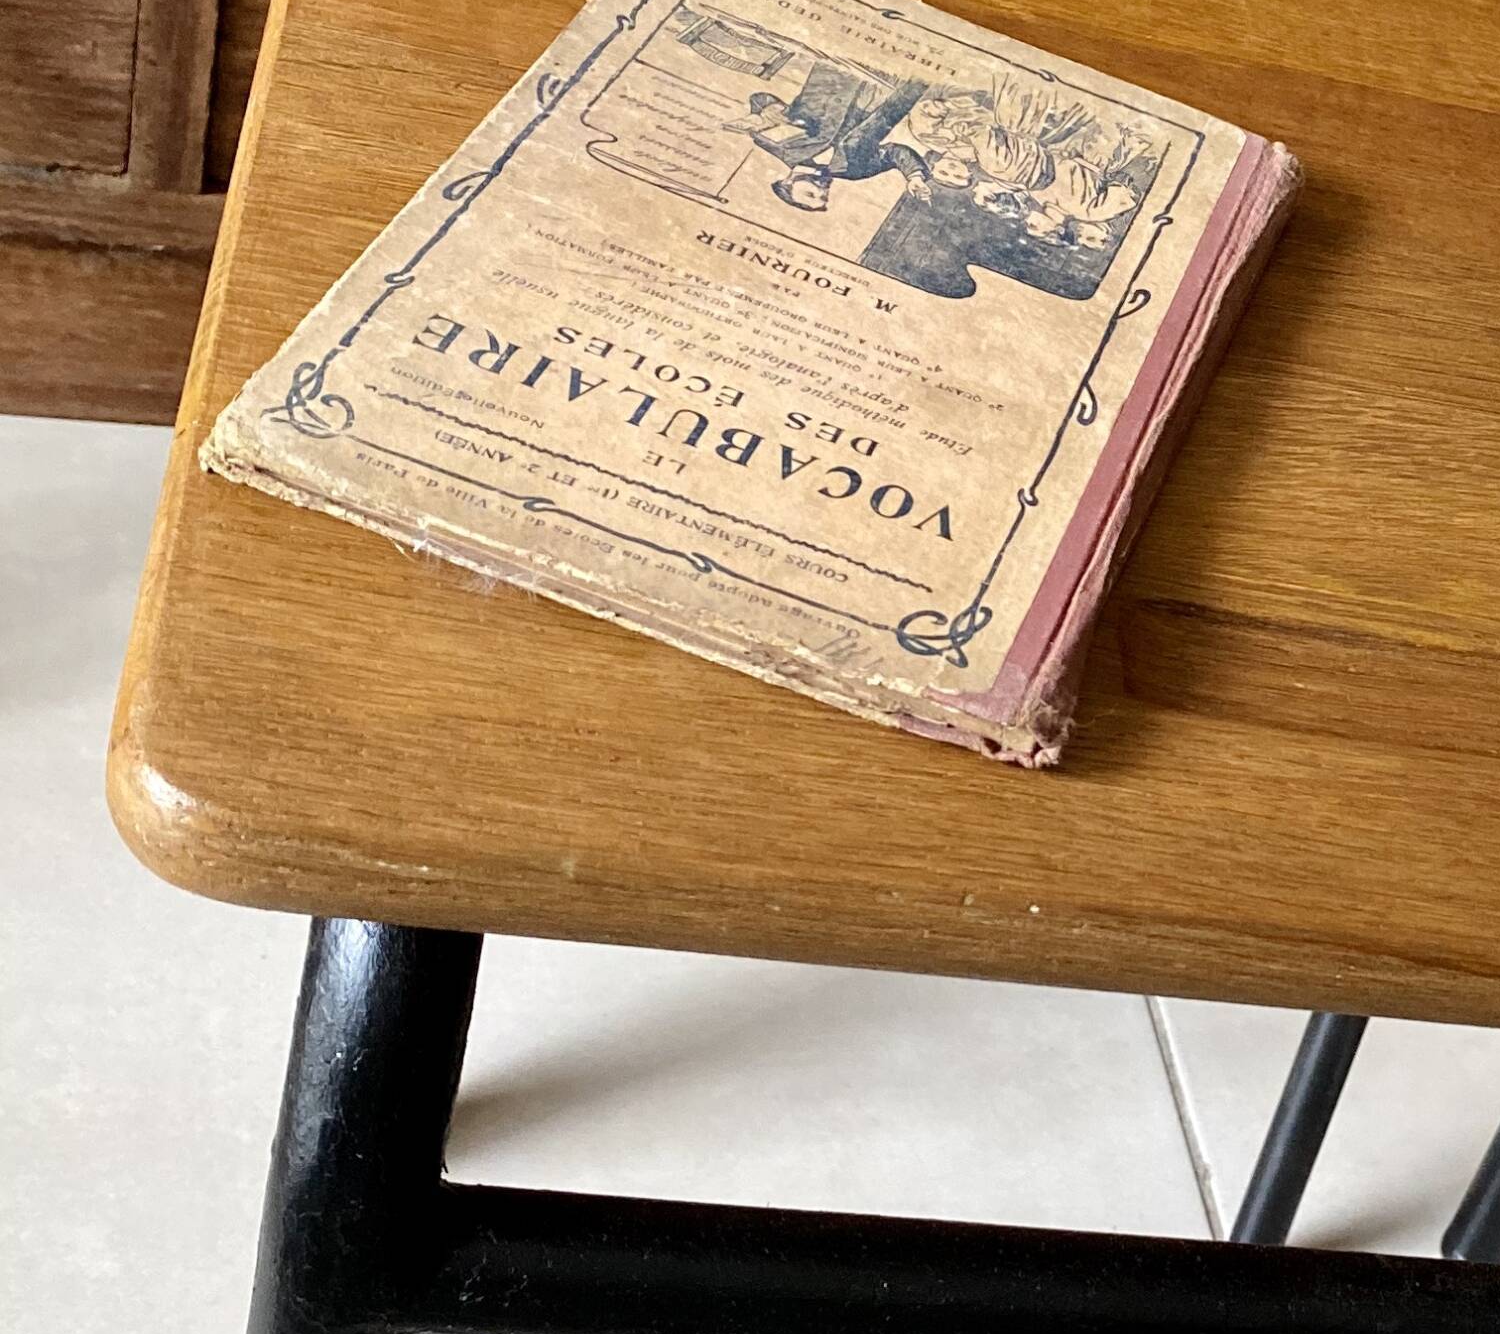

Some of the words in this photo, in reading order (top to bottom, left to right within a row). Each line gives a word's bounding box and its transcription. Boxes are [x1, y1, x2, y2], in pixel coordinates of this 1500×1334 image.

[837, 24, 956, 76] LIBRAIRIE
[692, 228, 852, 297] FOURNIER
[487, 268, 560, 300] usuelle
[682, 271, 711, 287] PAR
[566, 297, 635, 330] langue
[865, 295, 898, 315] M.
[642, 326, 664, 341] la
[670, 337, 697, 353] de
[701, 330, 722, 344] et
[550, 324, 745, 407] ÉCOLES
[703, 349, 752, 372] mots
[873, 343, 921, 365] QUANT
[757, 369, 792, 389] des
[933, 380, 984, 403] QUANT
[799, 384, 906, 429] méthodique
[408, 312, 953, 541] VOCABULAIRE
[781, 409, 879, 457] DES
[352, 452, 409, 478] Paris
[640, 450, 687, 475] LE
[545, 468, 577, 486] ET
[782, 553, 849, 584] COURS
